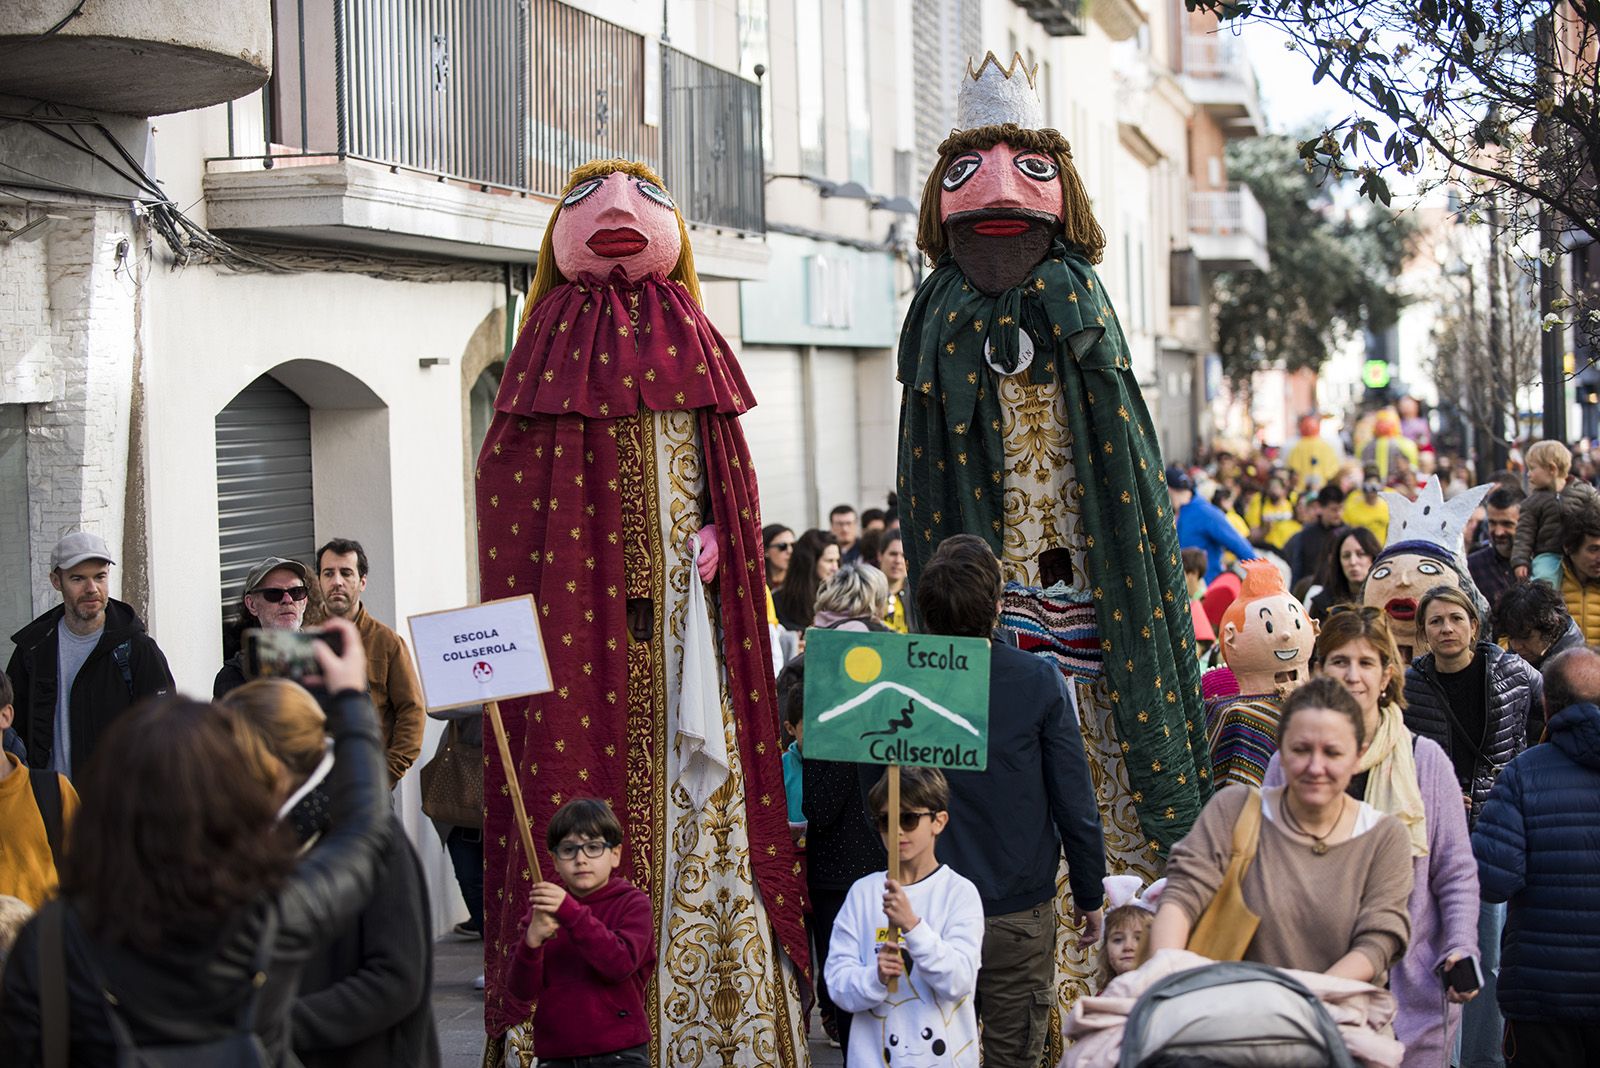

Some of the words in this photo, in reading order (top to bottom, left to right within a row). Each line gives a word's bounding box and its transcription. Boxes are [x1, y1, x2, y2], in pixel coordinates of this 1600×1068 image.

[453, 628, 499, 644] ESCOLA
[443, 642, 517, 662] COLLSEROLA
[907, 641, 969, 671] Escola
[869, 738, 979, 767] Collserola
